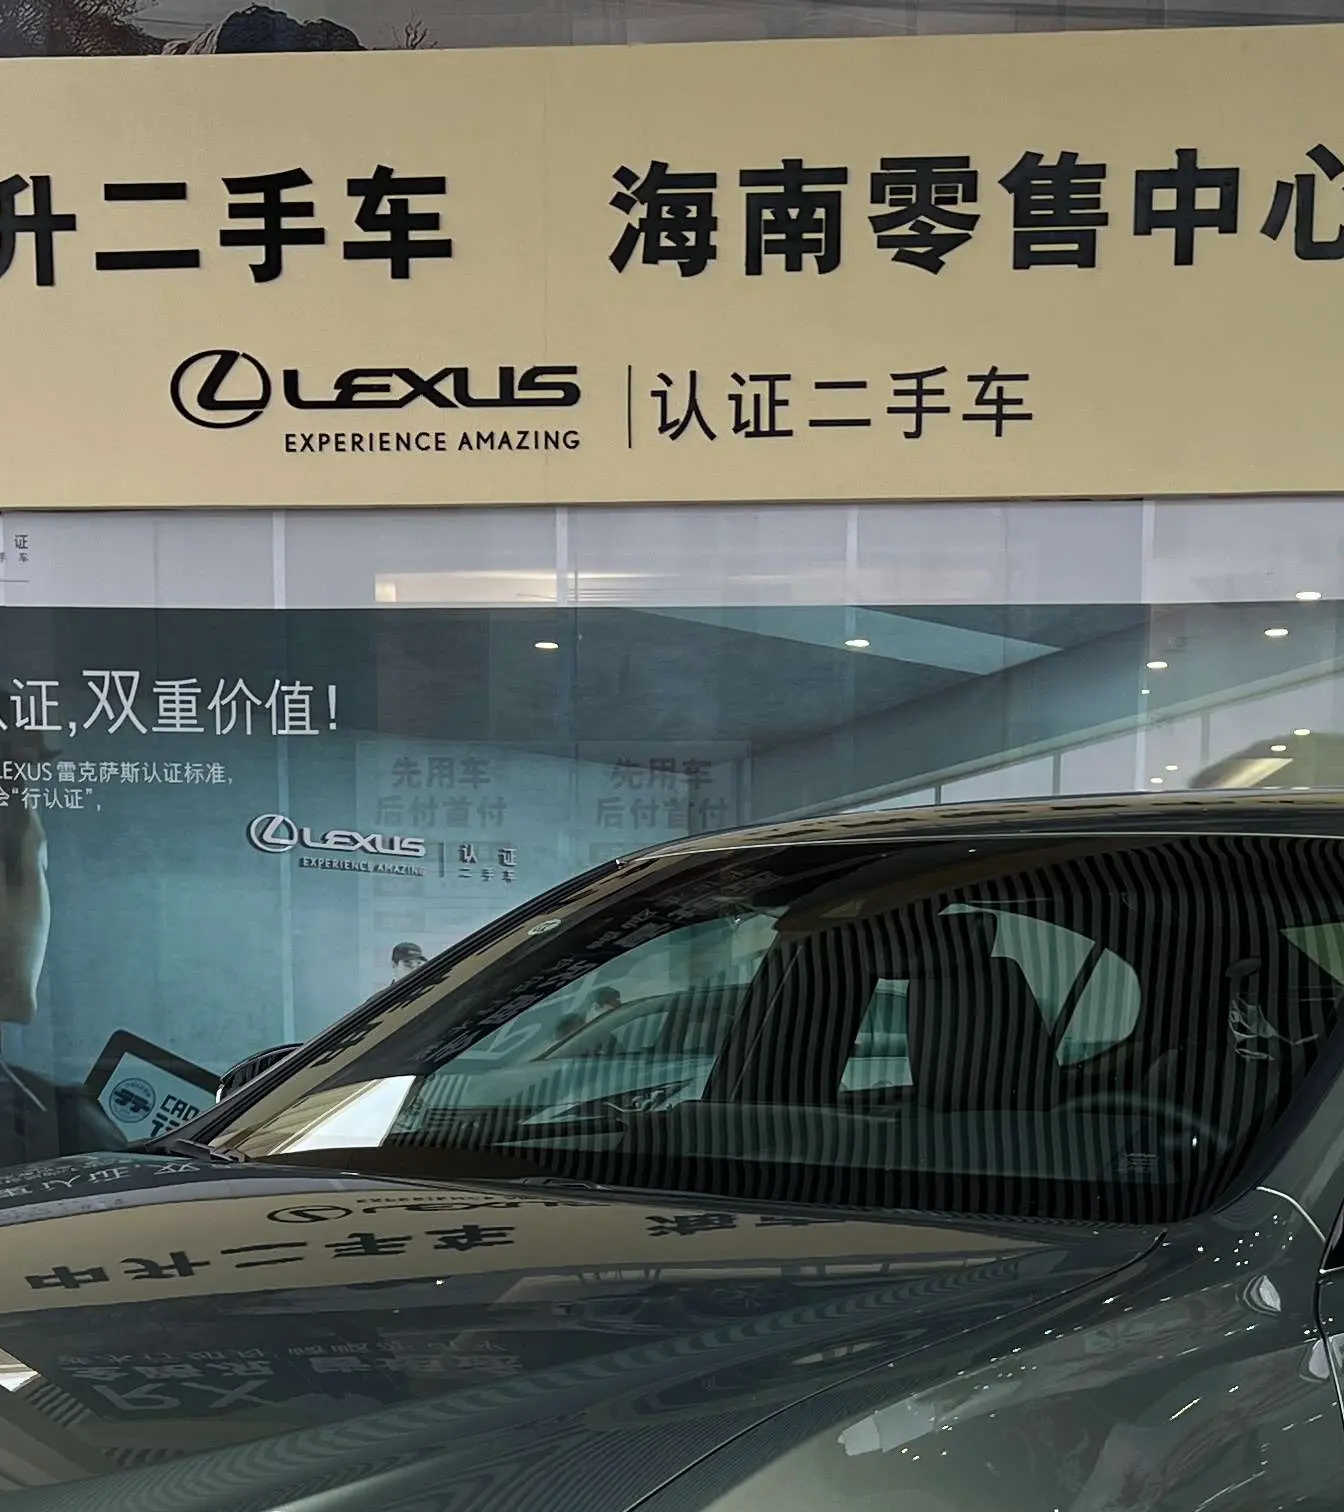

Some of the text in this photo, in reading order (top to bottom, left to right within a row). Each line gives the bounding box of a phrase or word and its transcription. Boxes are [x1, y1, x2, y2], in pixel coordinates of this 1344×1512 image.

[283, 365, 581, 409] LEXUS
[651, 365, 1033, 442] 认证二手车
[285, 430, 581, 452] EXPERIENCE AMAZING
[302, 827, 426, 857] LEXUS
[459, 844, 517, 867] 认证
